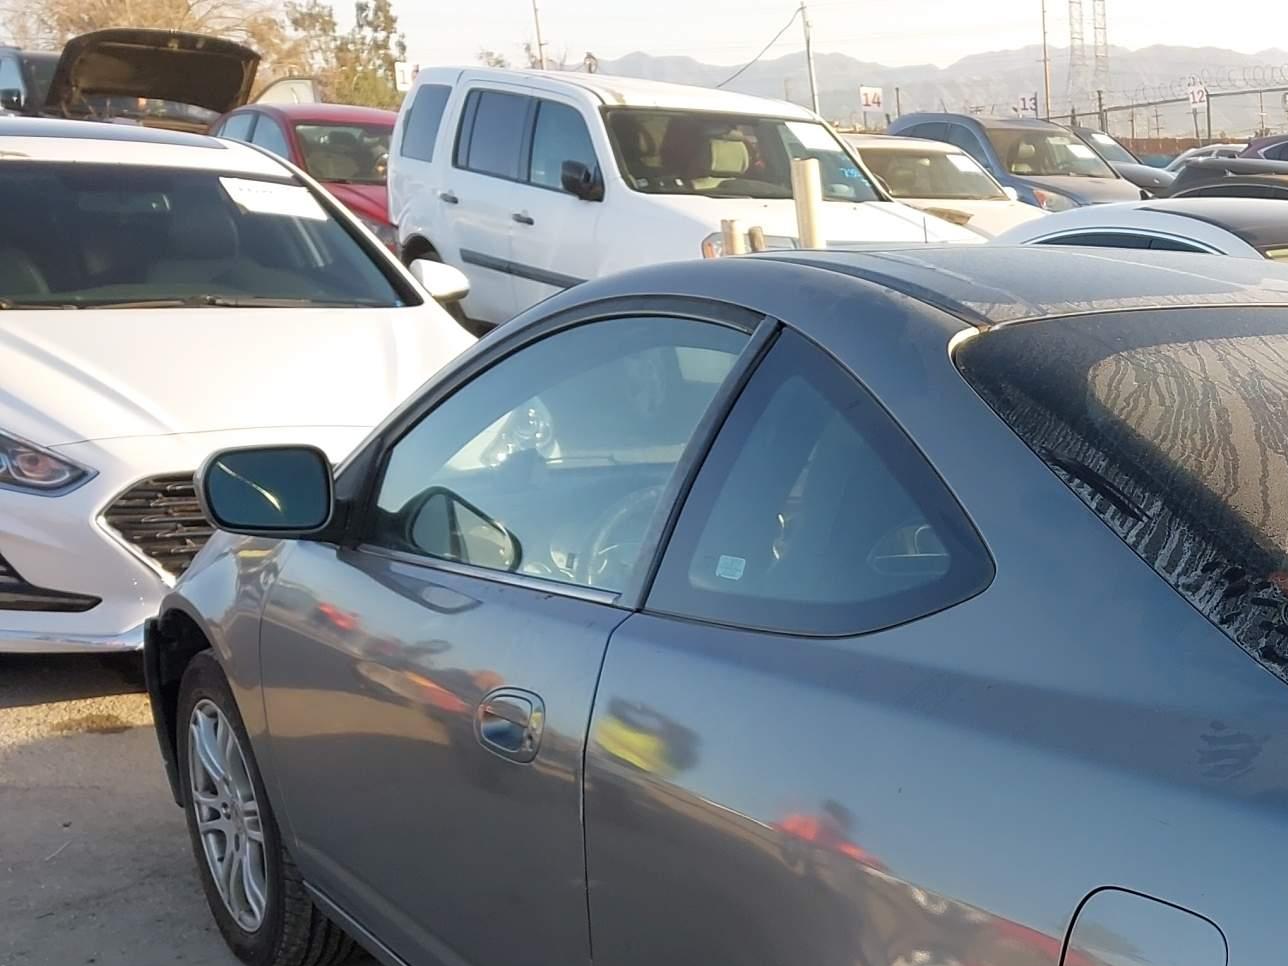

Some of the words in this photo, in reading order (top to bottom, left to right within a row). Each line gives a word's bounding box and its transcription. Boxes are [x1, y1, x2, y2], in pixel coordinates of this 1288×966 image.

[862, 92, 881, 108] 14
[1020, 97, 1038, 112] 13
[1189, 89, 1207, 105] 12
